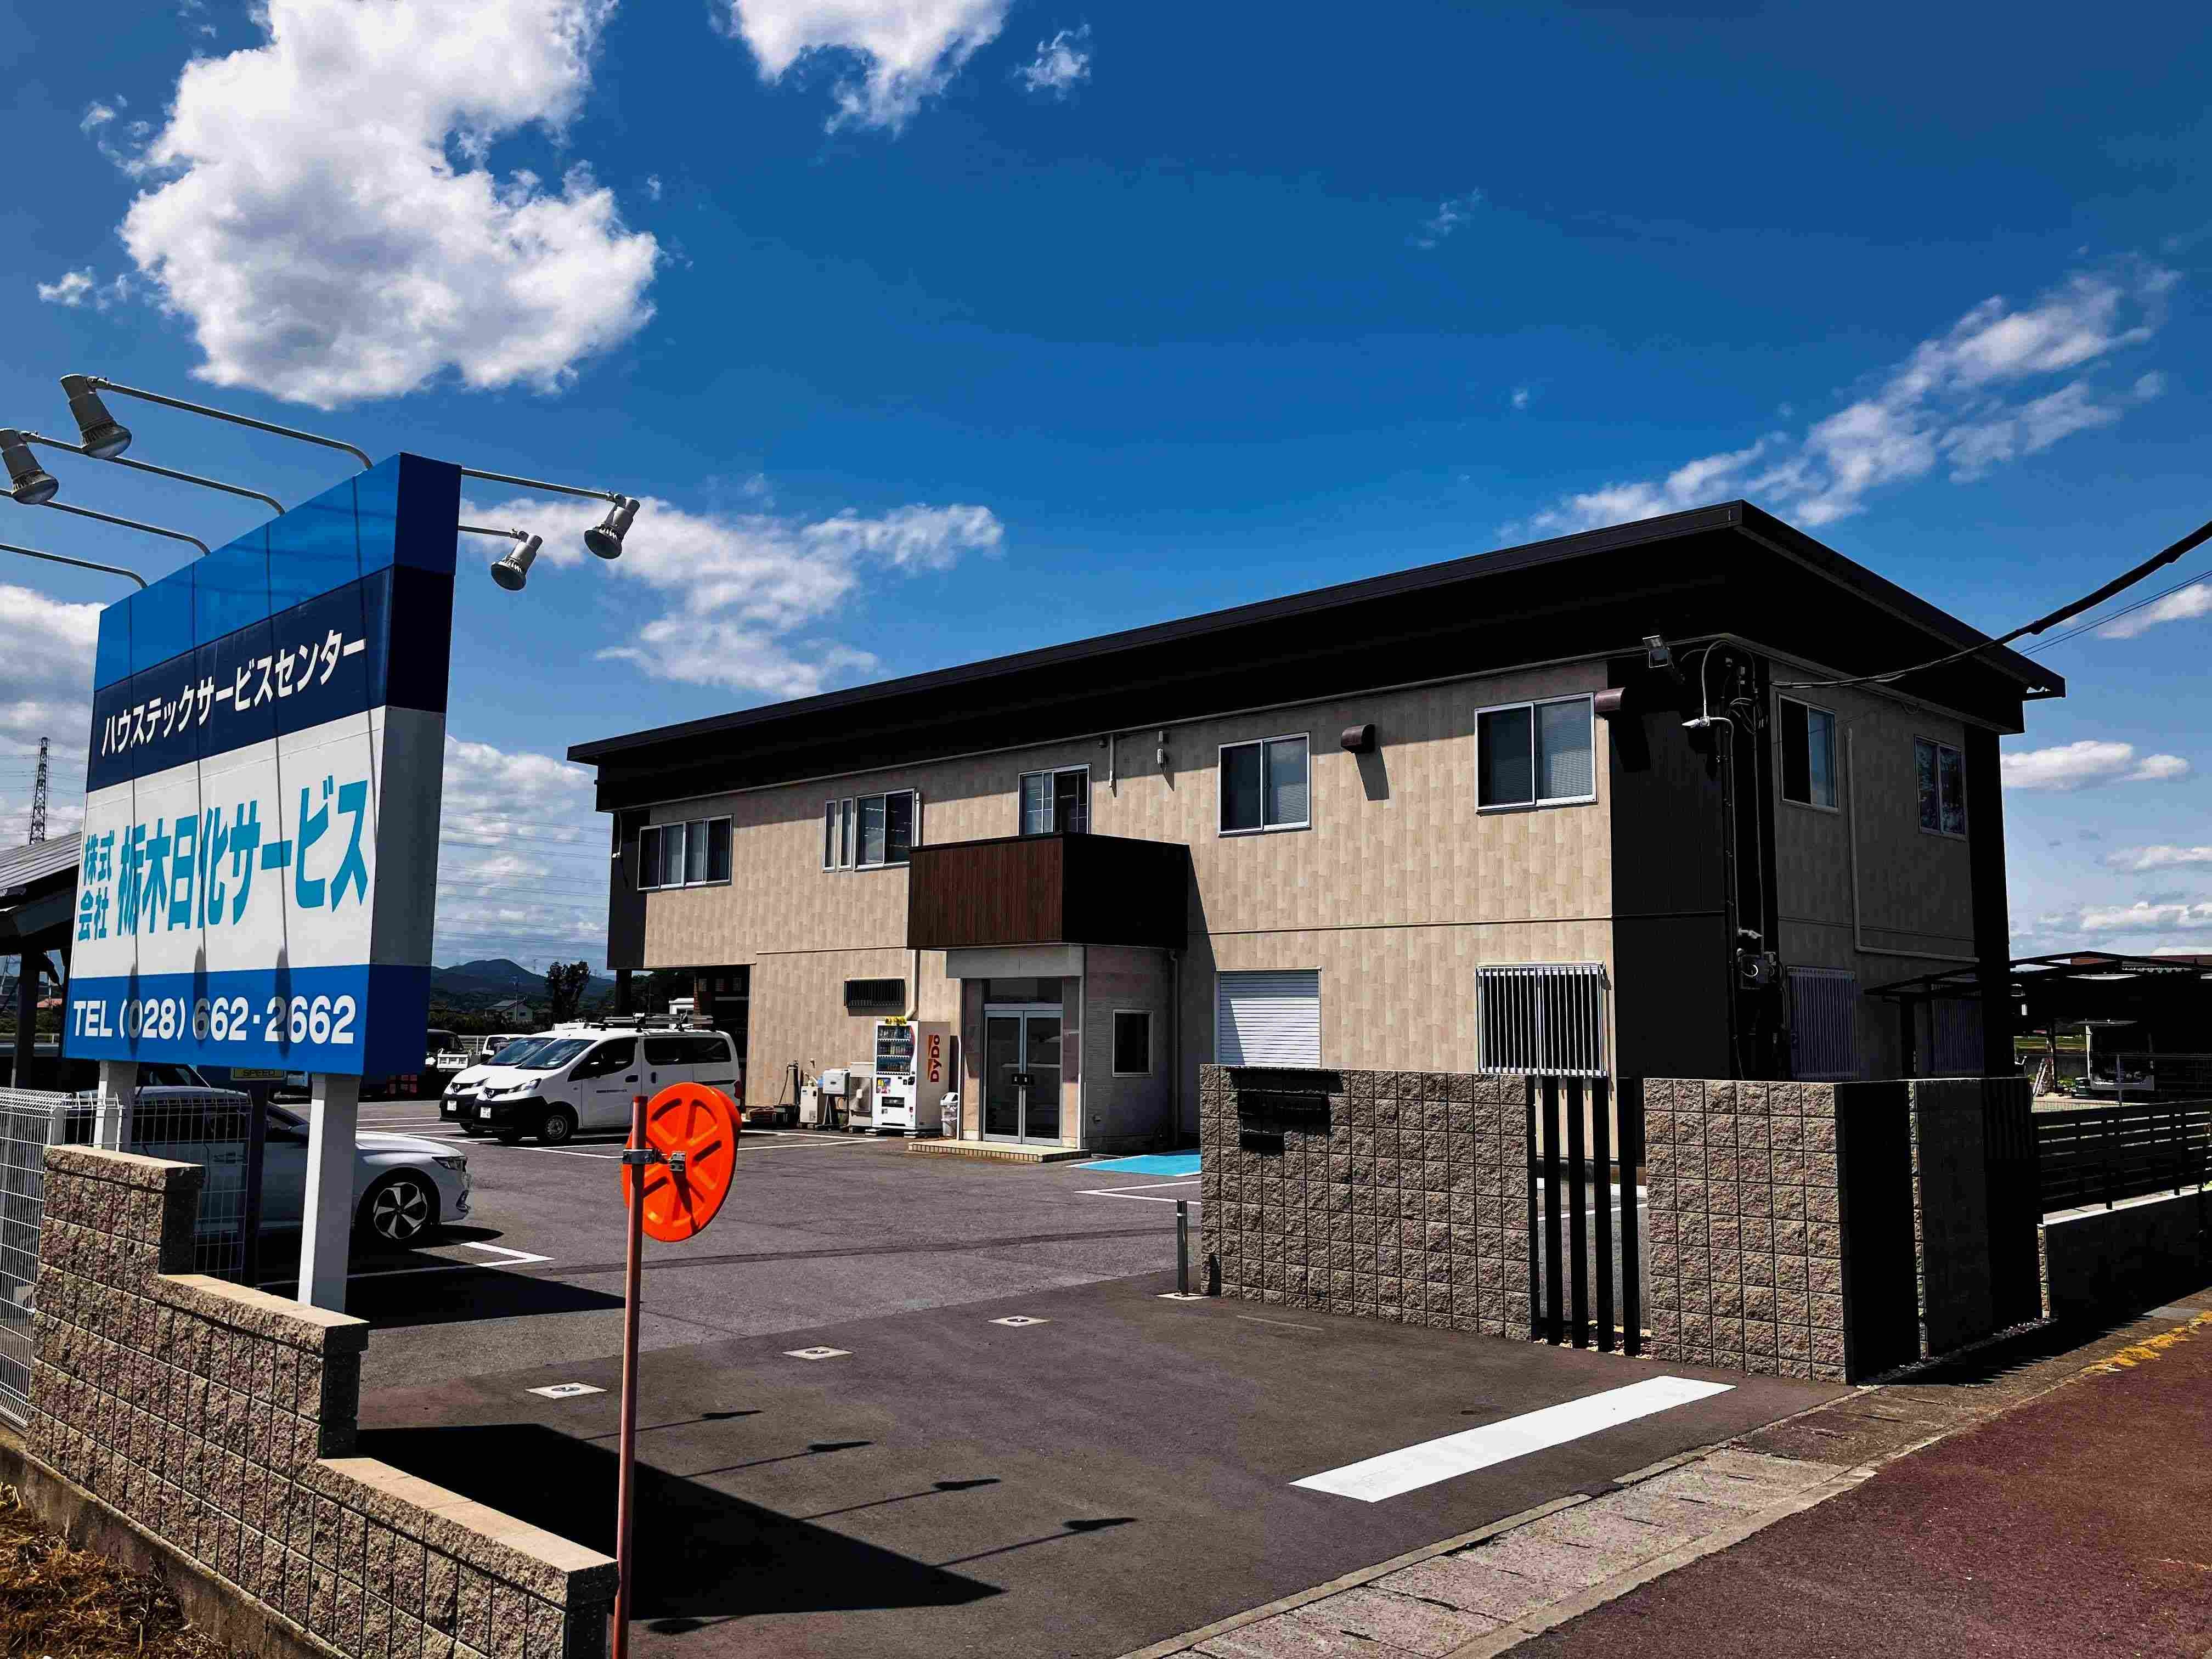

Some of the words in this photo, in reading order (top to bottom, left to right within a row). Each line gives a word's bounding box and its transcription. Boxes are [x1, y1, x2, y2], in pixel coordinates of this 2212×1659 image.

[102, 629, 365, 757] ハウステックサービスセンター
[74, 1000, 112, 1037] TEL
[119, 996, 185, 1041] (028)
[930, 1034, 941, 1082] DyDo
